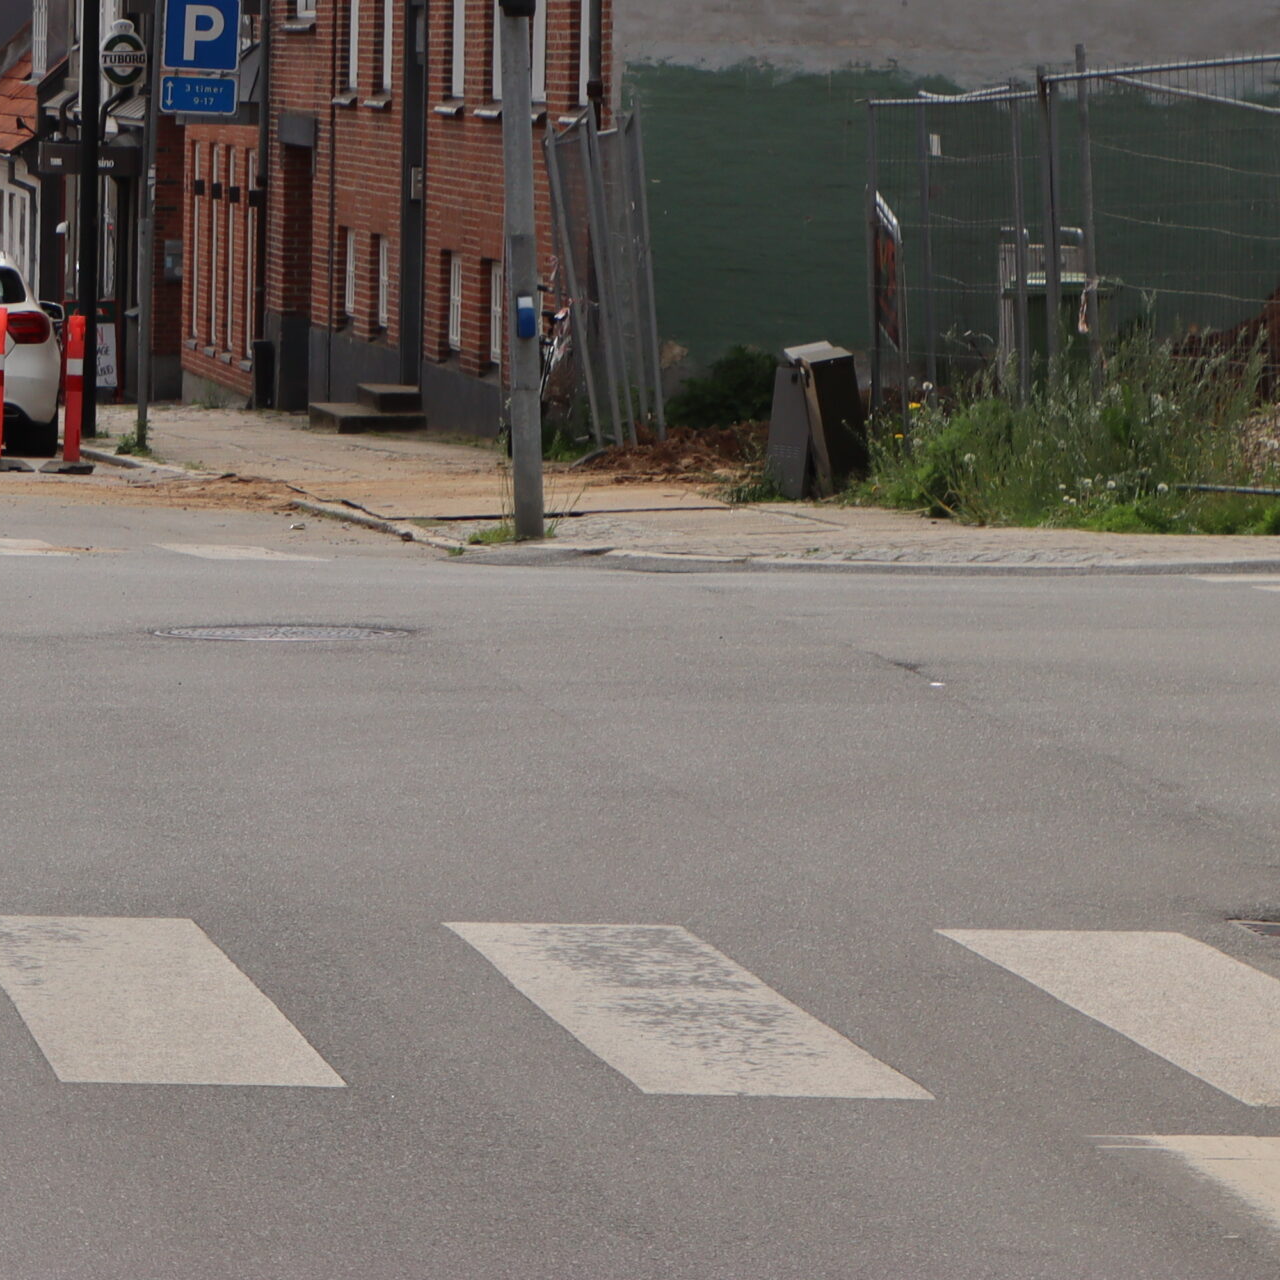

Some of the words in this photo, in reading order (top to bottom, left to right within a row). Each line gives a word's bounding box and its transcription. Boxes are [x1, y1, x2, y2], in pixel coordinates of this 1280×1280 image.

[183, 4, 225, 61] P
[102, 54, 145, 65] TUBORG
[185, 84, 191, 93] 3
[195, 84, 224, 94] timer
[193, 96, 215, 105] 9-17
